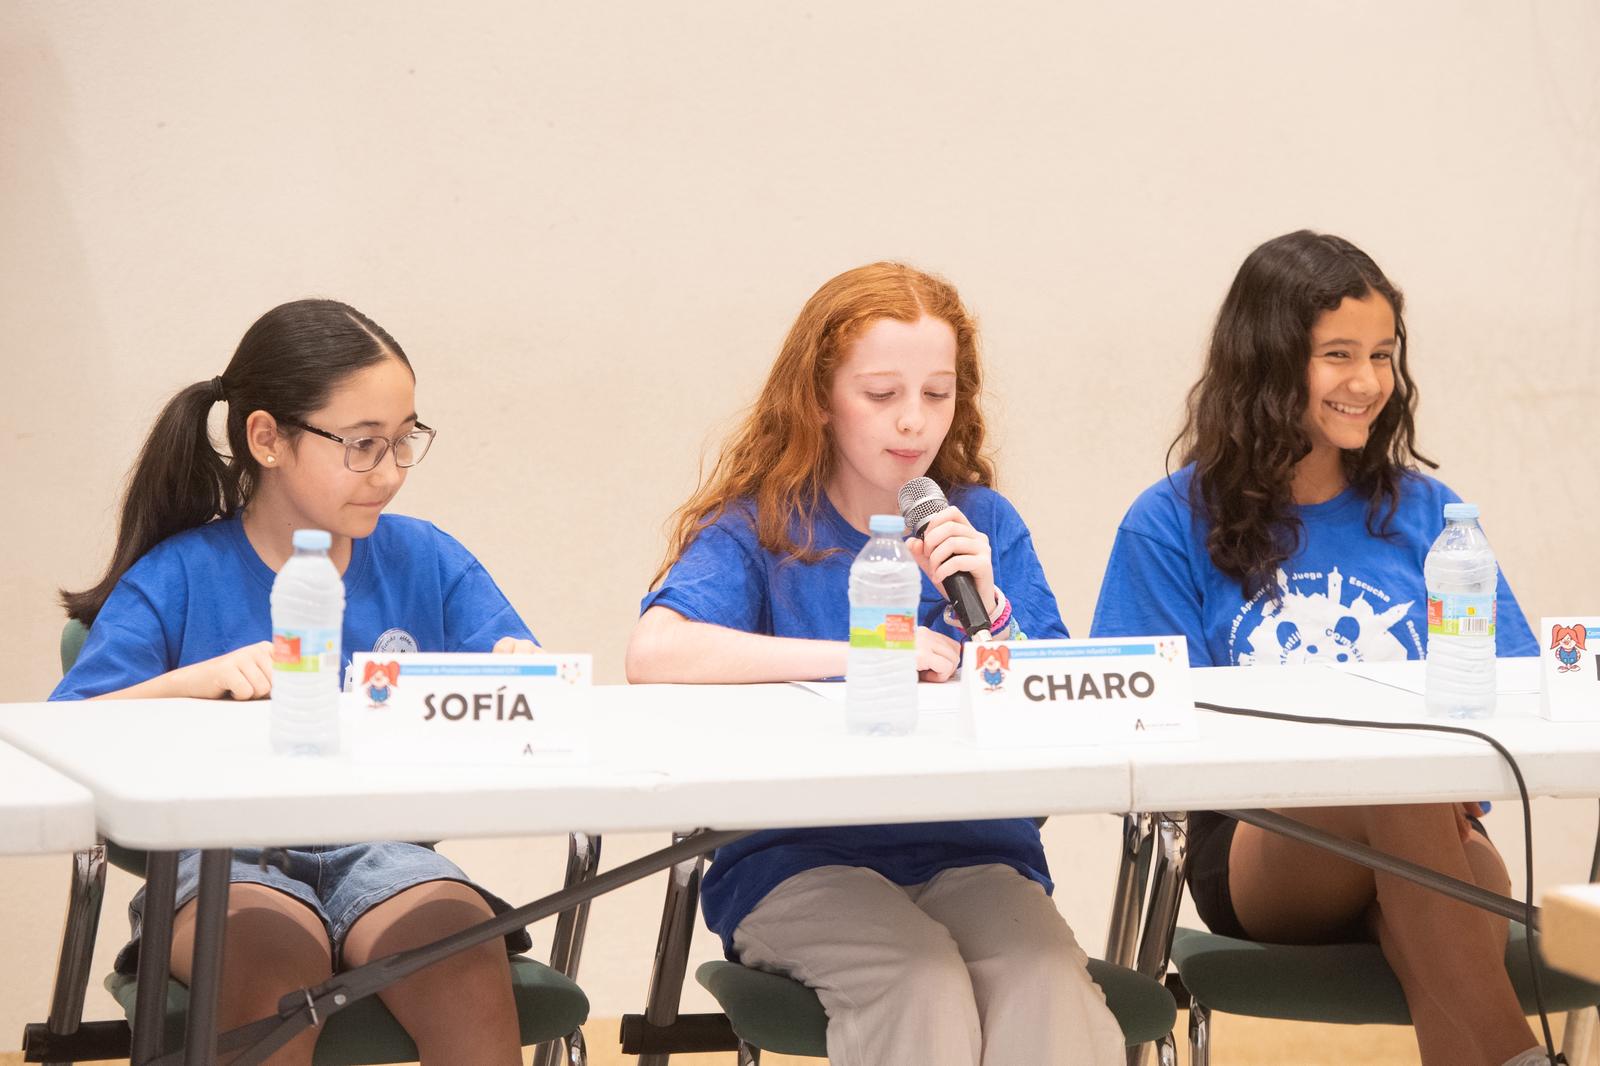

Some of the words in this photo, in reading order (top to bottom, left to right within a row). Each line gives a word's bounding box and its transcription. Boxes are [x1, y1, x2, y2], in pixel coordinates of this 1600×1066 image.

[1292, 571, 1323, 581] Juega
[1349, 576, 1391, 603] Escucha
[1023, 671, 1155, 702] CHARO
[424, 685, 534, 721] SOFÍA
